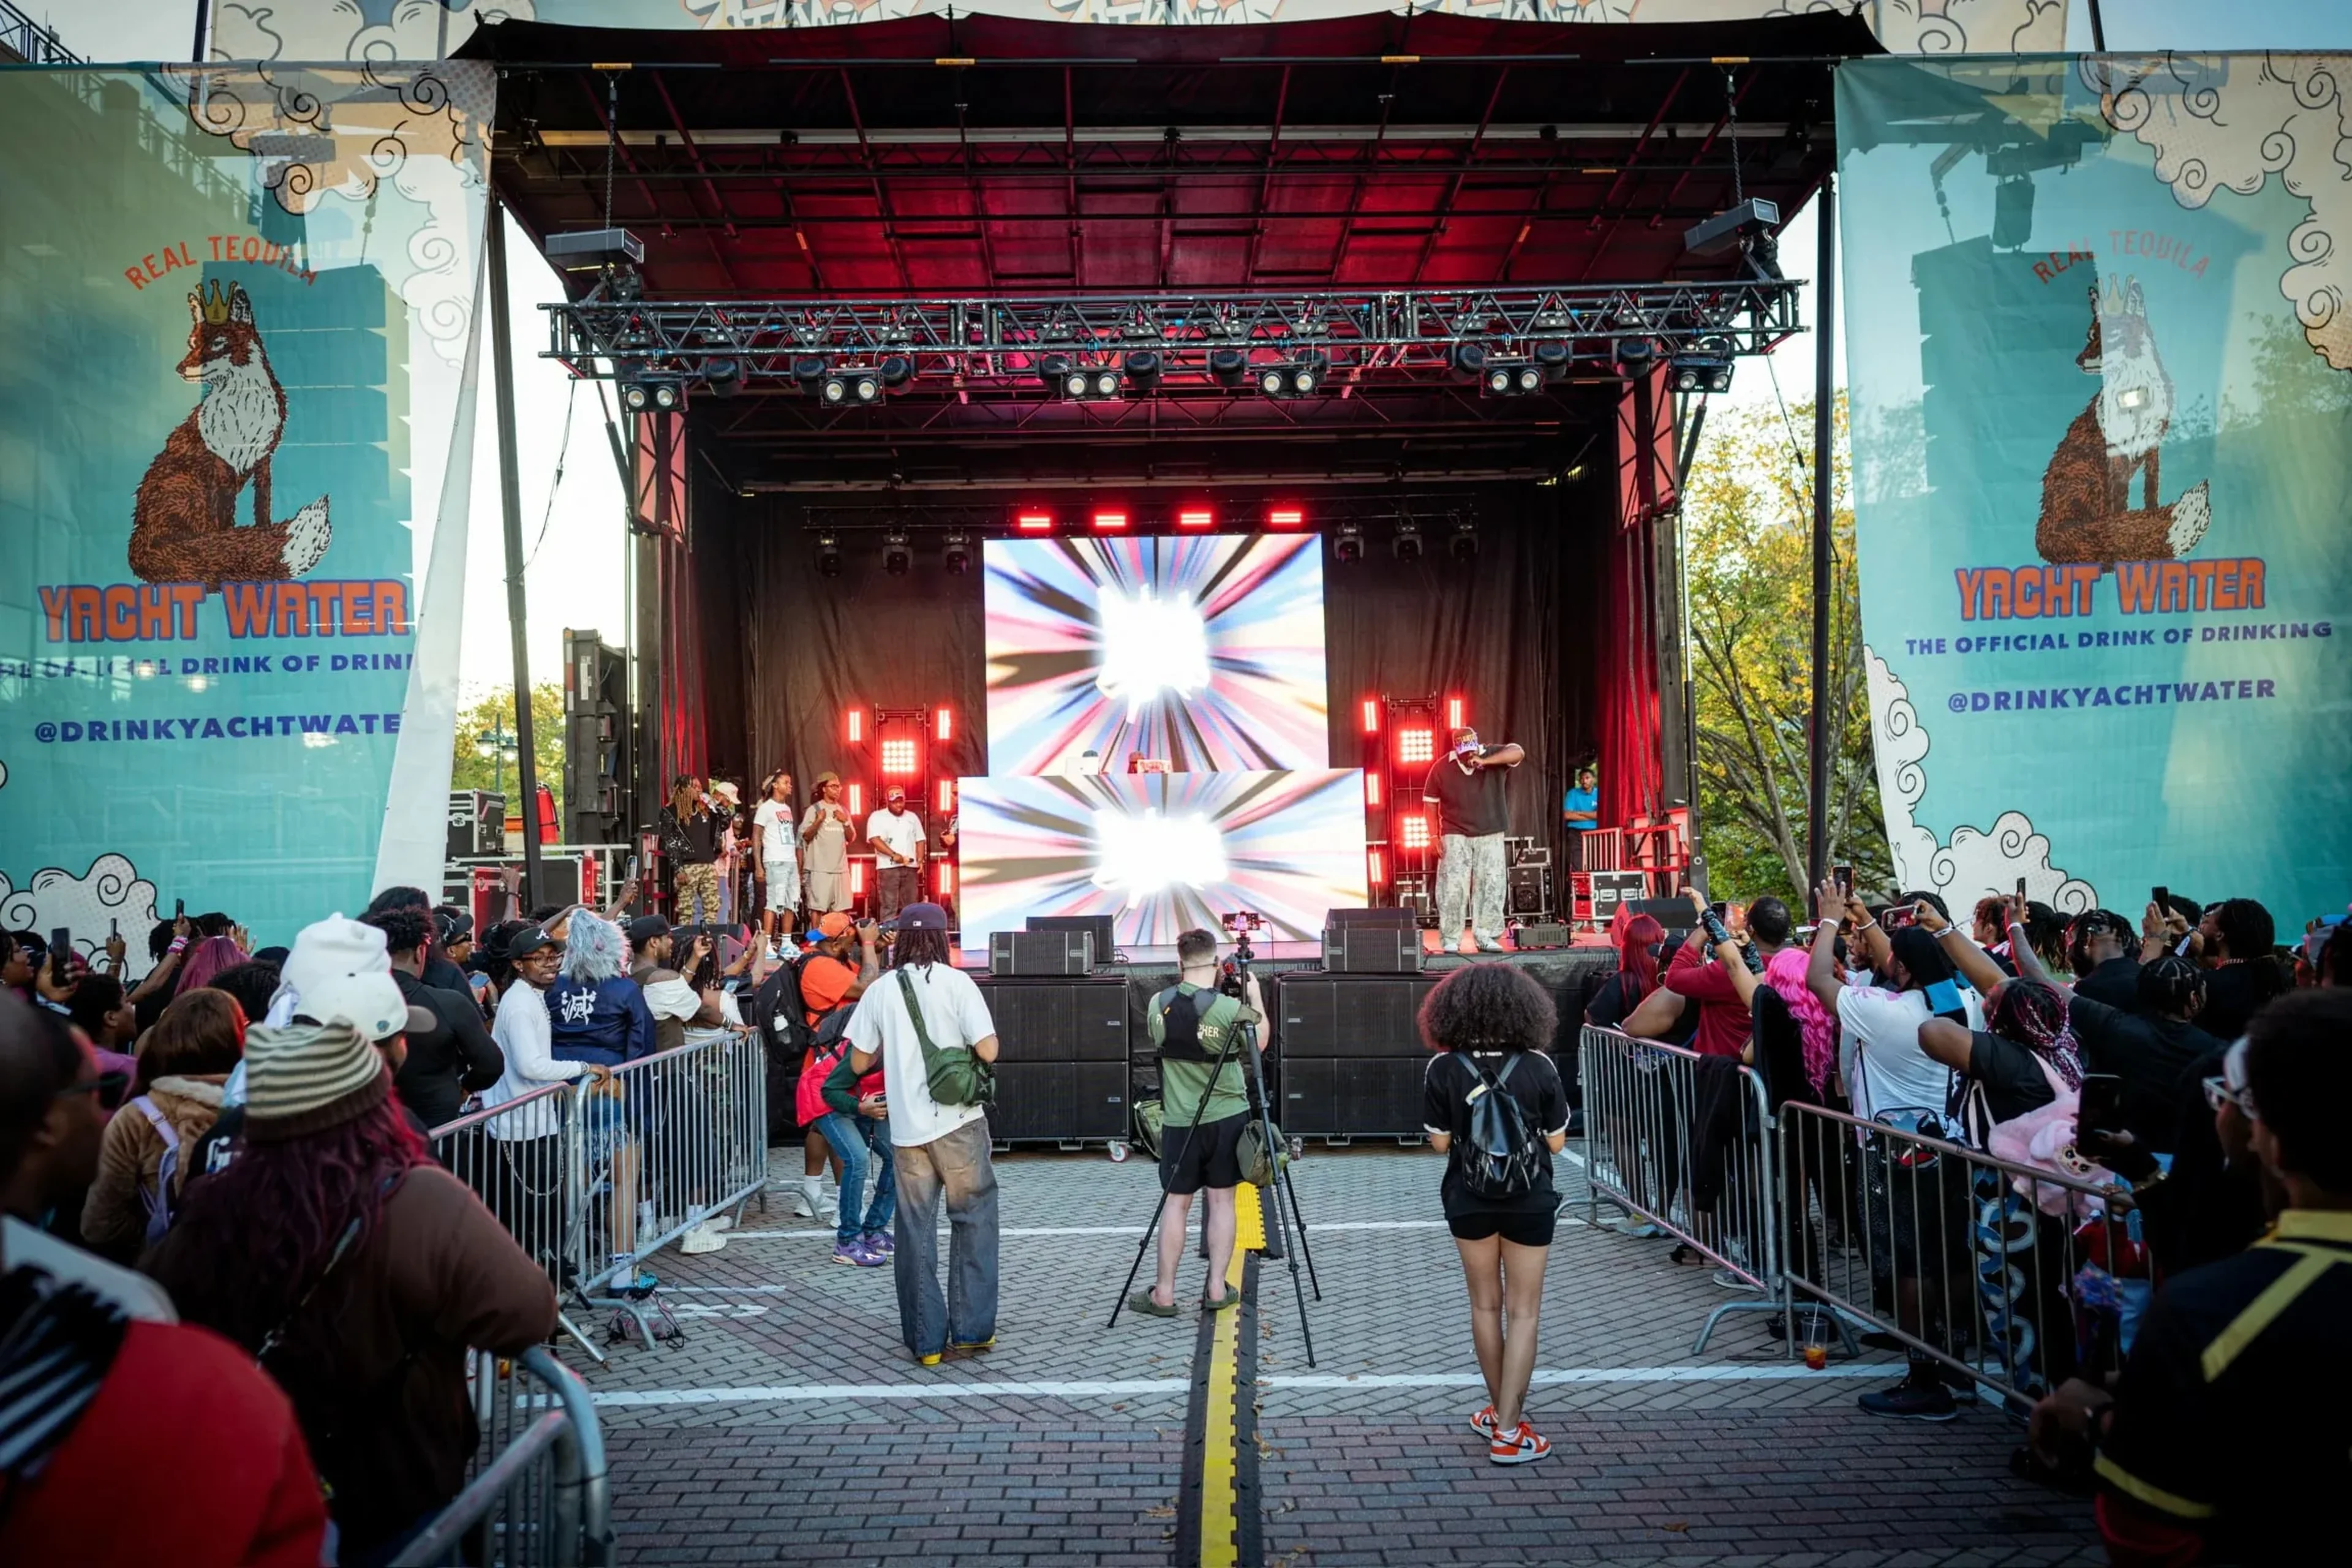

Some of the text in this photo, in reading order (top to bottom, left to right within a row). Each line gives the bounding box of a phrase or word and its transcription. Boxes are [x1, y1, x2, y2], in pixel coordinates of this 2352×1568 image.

[125, 235, 317, 290] REAL TEQUILA
[2032, 230, 2210, 284] REAL TEQUILA
[38, 578, 410, 643] YACHT WATER
[1954, 557, 2267, 621] YACHT WATER
[181, 654, 273, 675] DRINK
[280, 654, 320, 673] OF
[1906, 621, 2332, 655] THE OFFICIAL DRINK OF DRINKING
[1947, 679, 2276, 714] @DRINKYACHTWATER
